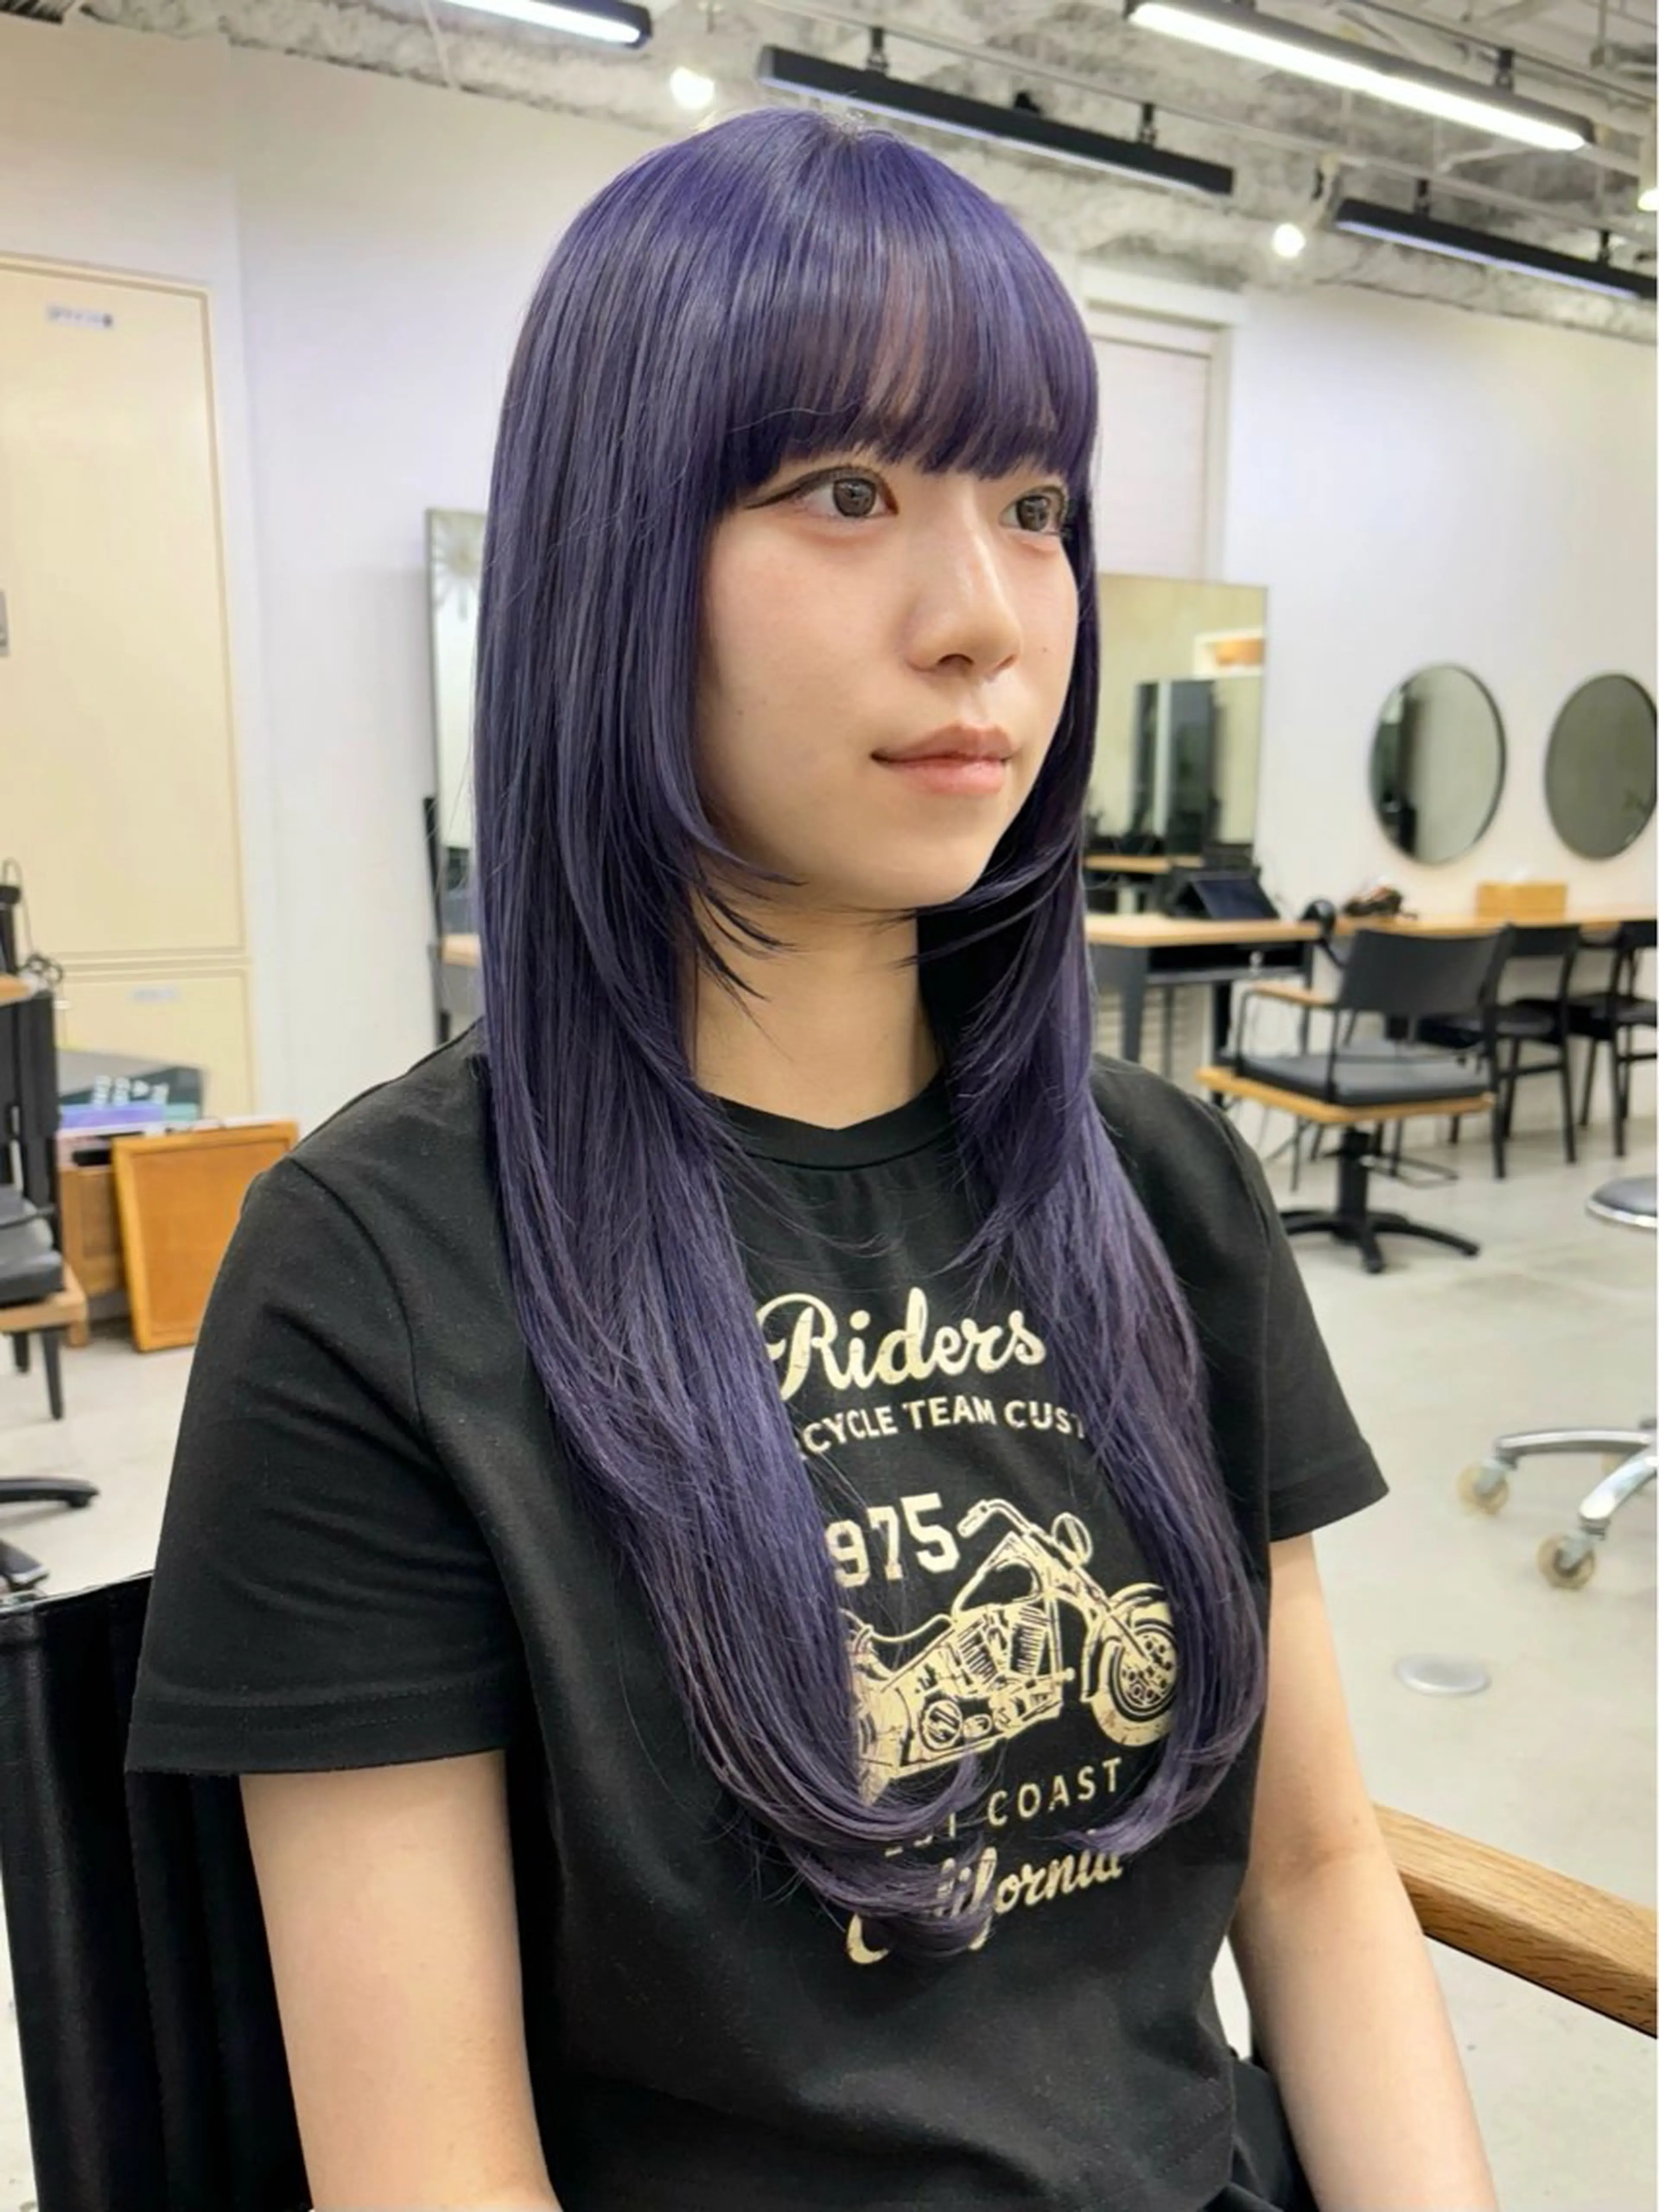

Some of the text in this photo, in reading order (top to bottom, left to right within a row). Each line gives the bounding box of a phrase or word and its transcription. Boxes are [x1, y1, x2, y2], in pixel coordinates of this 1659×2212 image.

[756, 1287, 1046, 1401] Riders
[794, 1405, 899, 1460] CYCLE
[902, 1395, 997, 1430] TEAM
[988, 1756, 1122, 1827] COAST
